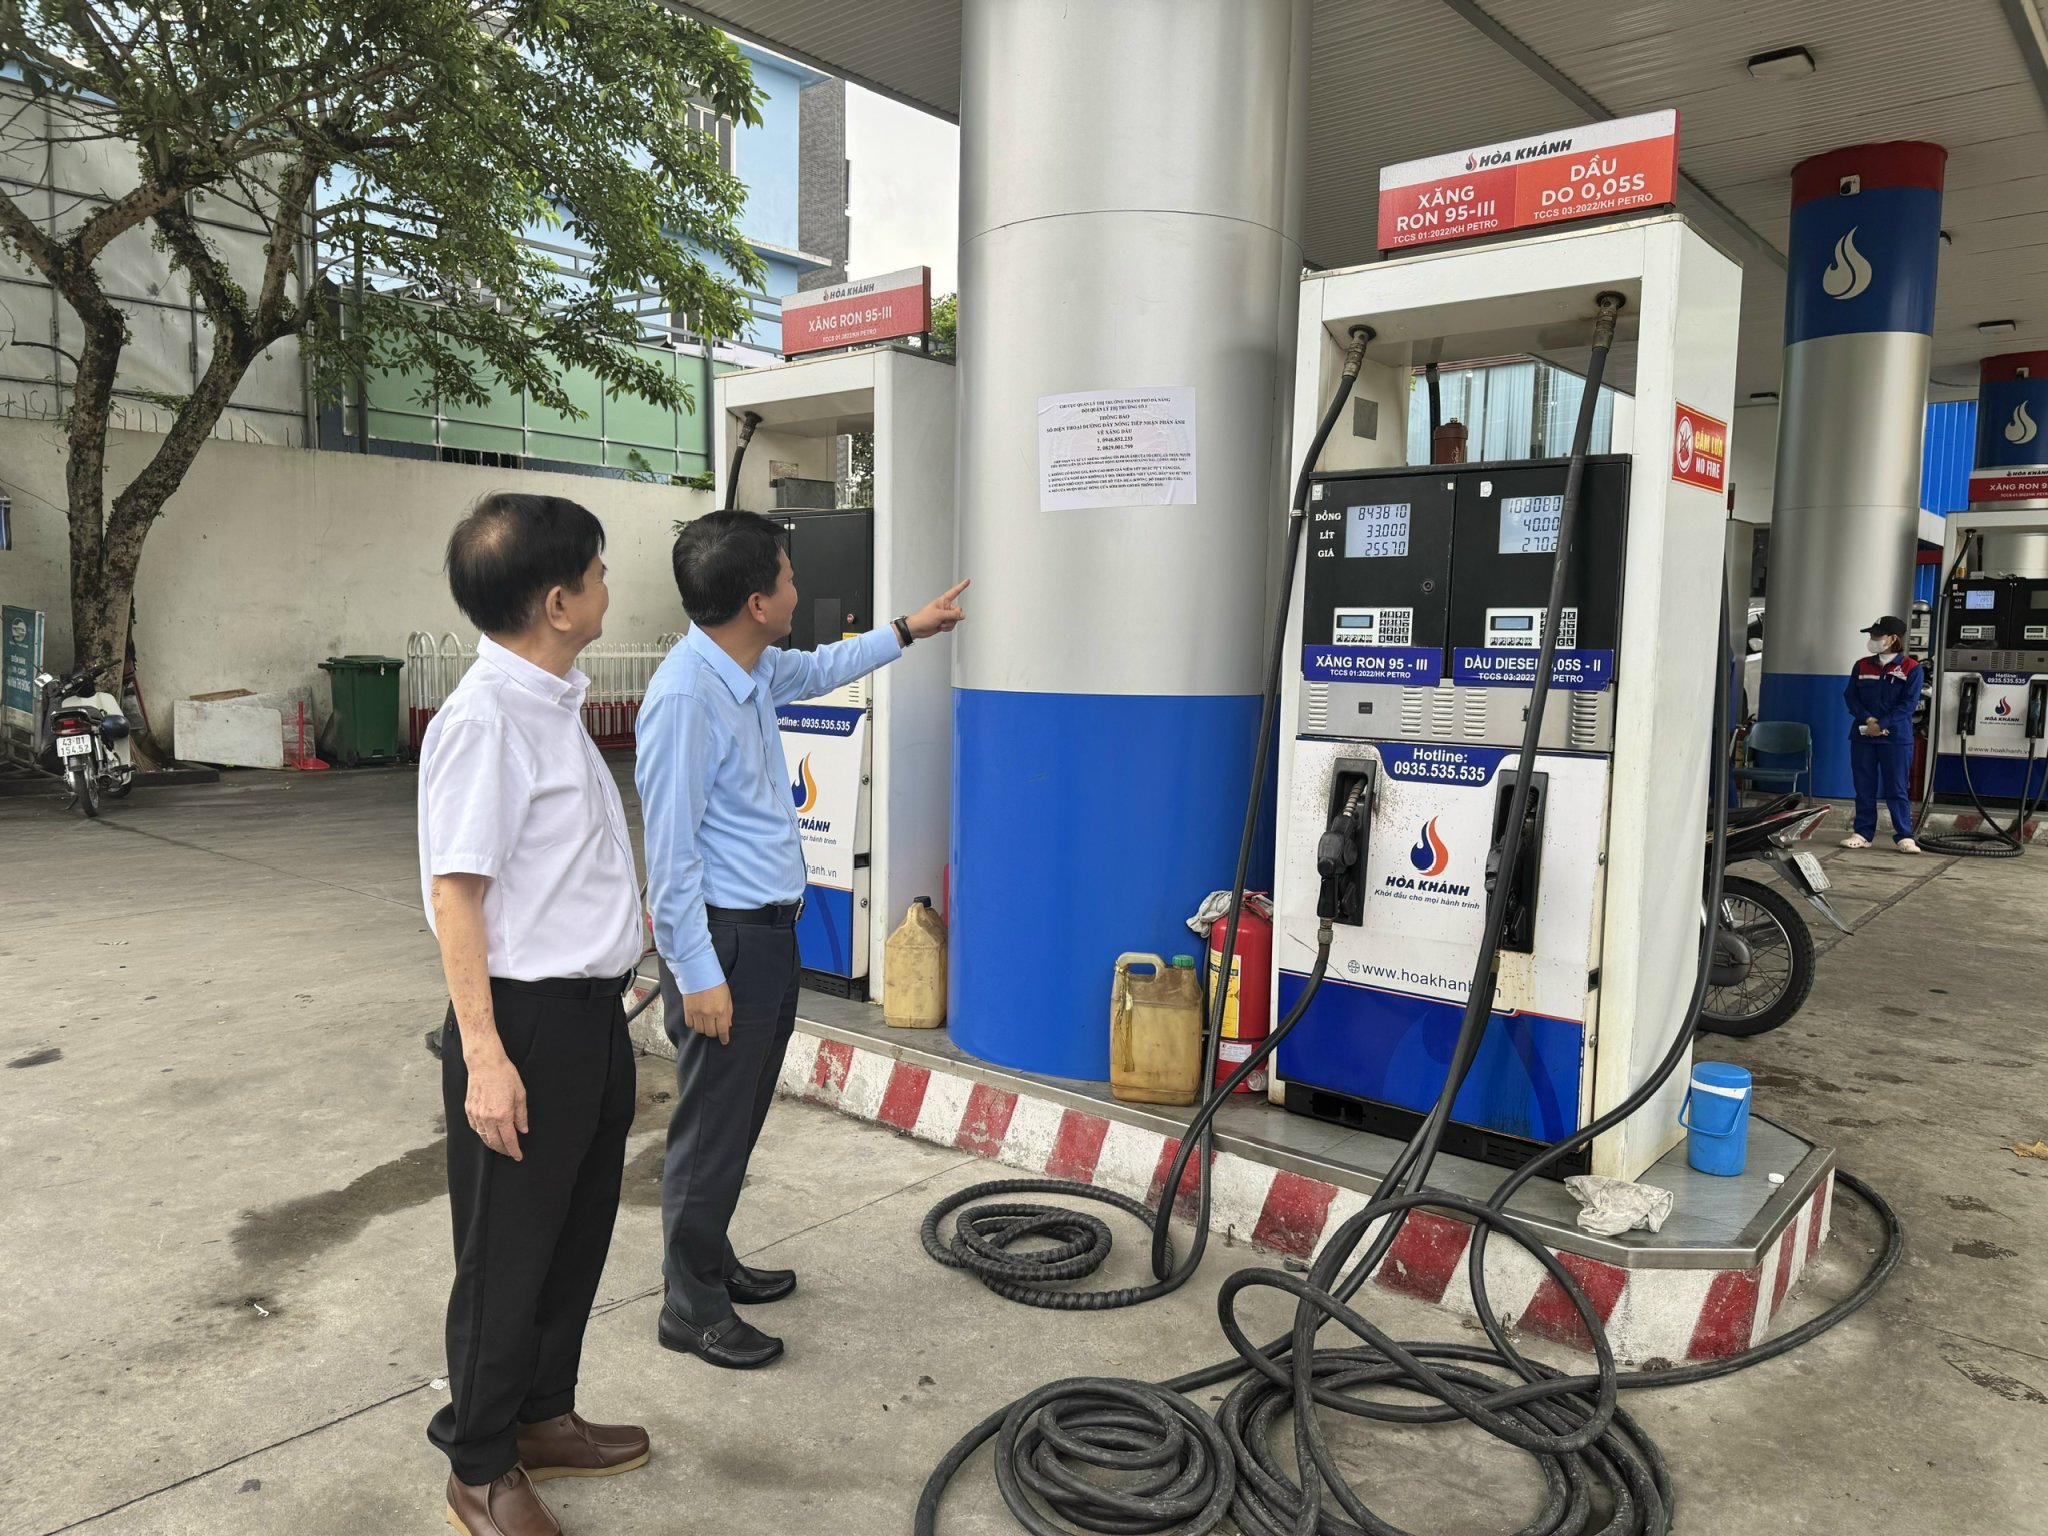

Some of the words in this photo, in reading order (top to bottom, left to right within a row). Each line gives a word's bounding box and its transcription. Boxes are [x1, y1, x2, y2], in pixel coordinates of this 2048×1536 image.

[1479, 150, 1511, 168] HÒA
[1514, 139, 1573, 161] KHÁNH
[1570, 154, 1617, 182] DẦU
[1417, 185, 1475, 210] XĂNG
[1542, 187, 1574, 207] DO
[1581, 172, 1645, 200] 0,05S
[1533, 209, 1559, 220] TCCS
[1562, 199, 1615, 215] 03:2022/KH
[1618, 193, 1653, 206] PETRO
[1397, 211, 1438, 232] RON
[1445, 200, 1495, 222] 95-III
[1393, 235, 1416, 244] TCCS
[1418, 225, 1465, 239] 01:2022/KH
[1467, 219, 1498, 231] PETRO
[830, 288, 846, 299] HÒA
[847, 283, 875, 297] KHÁNH
[808, 316, 837, 333] XĂNG
[839, 311, 862, 327] RON
[865, 306, 892, 323] 95-III
[1695, 456, 1706, 474] NO
[1706, 459, 1720, 479] FIRE
[1989, 482, 2016, 491] XĂNG
[1510, 496, 1561, 513] 108080
[1315, 510, 1342, 521] ĐỒNG
[1358, 505, 1407, 521] 843810
[1366, 523, 1406, 538] 33.000
[1523, 516, 1560, 532] 40.00
[1320, 530, 1335, 540] LÍT
[1318, 548, 1334, 558] GIÁ
[1365, 541, 1406, 556] 25570
[1316, 654, 1352, 668] XĂNG
[1356, 657, 1385, 669] RON
[1389, 658, 1404, 670] 95
[1416, 659, 1427, 671] III
[1551, 659, 1581, 673] ,05S
[1593, 659, 1601, 672] II
[1349, 670, 1385, 678] 01:2022/HK
[1387, 671, 1411, 679] PETRO
[1478, 673, 1502, 681] TCCS
[1553, 675, 1584, 683] PETRO
[777, 717, 800, 727] otline:
[801, 717, 851, 731] 0935.535.535
[1413, 748, 1468, 764] Hotline:
[1974, 747, 2028, 755] www.hoakhanh.v
[1394, 761, 1486, 781] 0935.535.535
[1385, 875, 1415, 889] HÒA
[1418, 880, 1470, 896] KHÁNH
[1393, 891, 1407, 899] đầu
[1440, 898, 1460, 907] hành
[1461, 901, 1480, 910] trình
